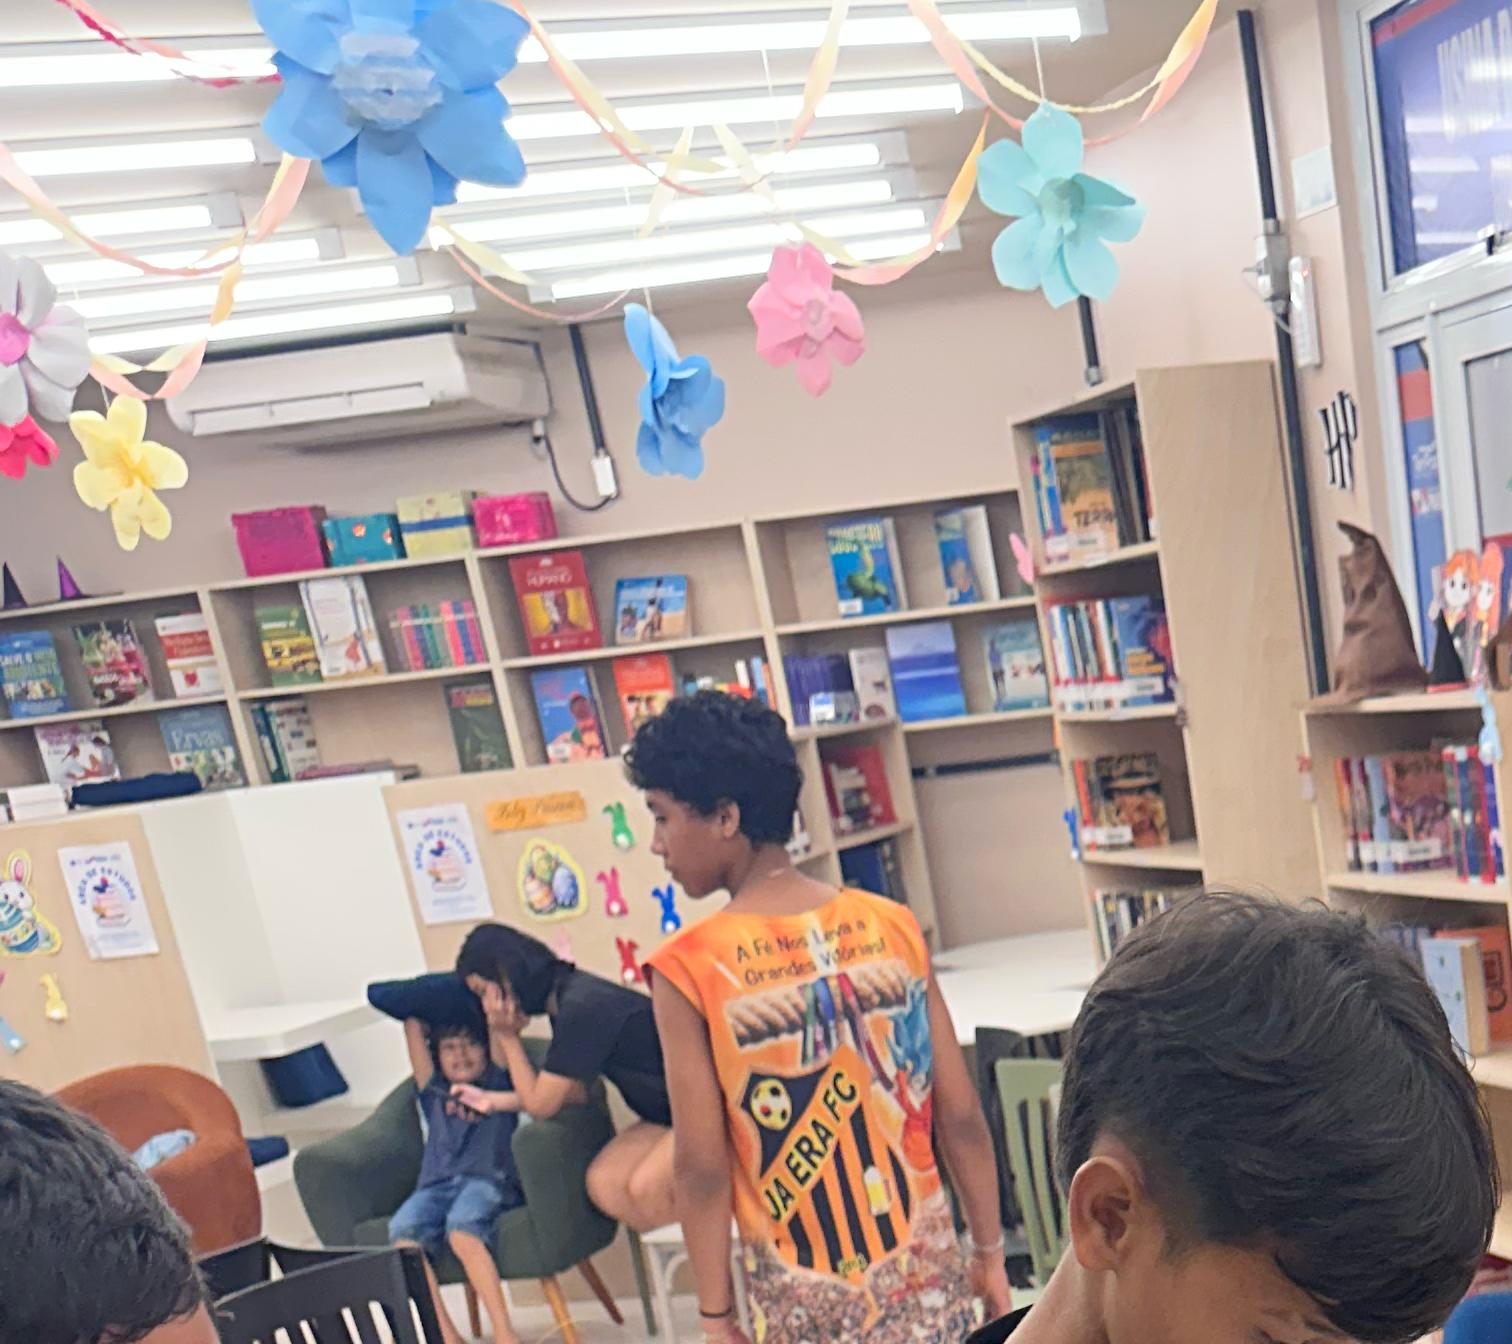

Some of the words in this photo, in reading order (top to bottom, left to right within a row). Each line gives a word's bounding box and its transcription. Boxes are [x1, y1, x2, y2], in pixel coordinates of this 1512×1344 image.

[736, 943, 751, 964] A
[776, 935, 809, 952] Nos
[811, 922, 853, 945] Leva
[856, 919, 866, 931] a
[744, 959, 817, 986] Grandes
[764, 1177, 795, 1222] JA
[784, 1118, 835, 1187] ERA
[822, 1070, 859, 1123] FC
